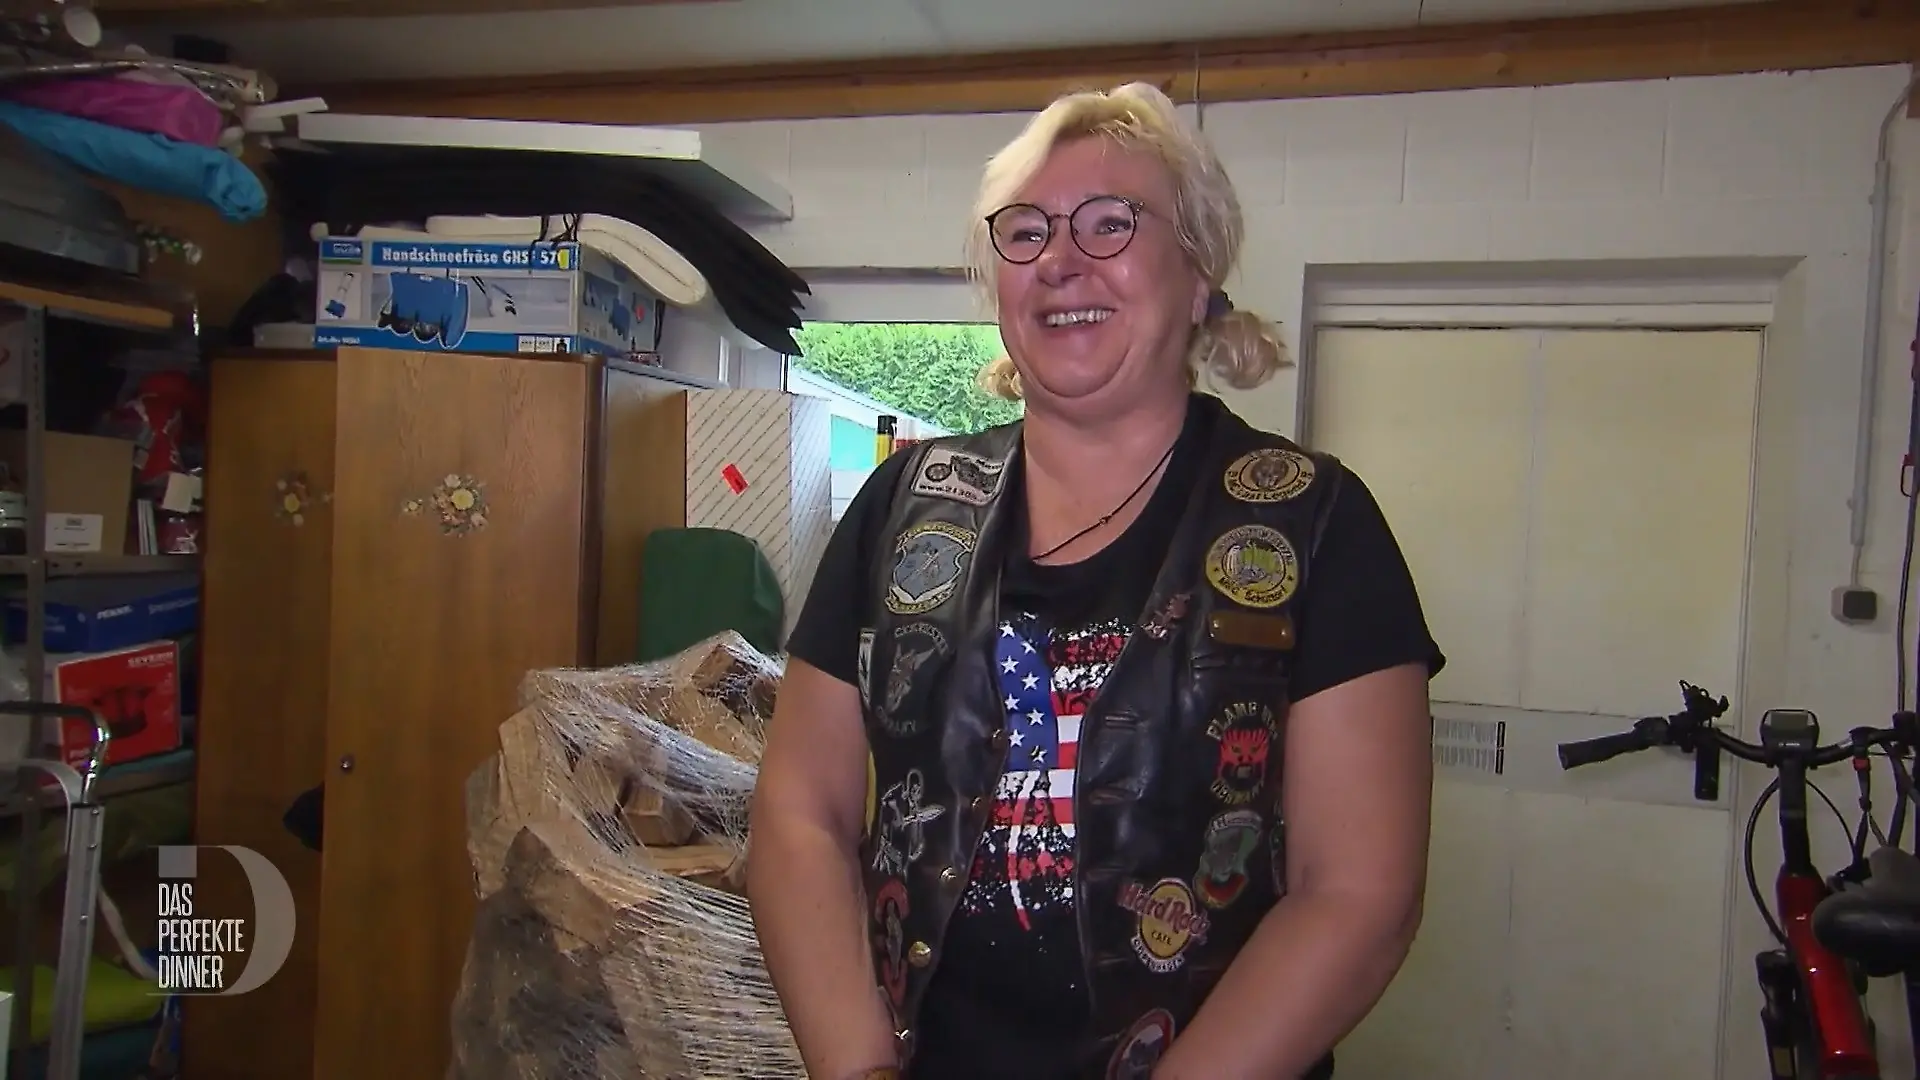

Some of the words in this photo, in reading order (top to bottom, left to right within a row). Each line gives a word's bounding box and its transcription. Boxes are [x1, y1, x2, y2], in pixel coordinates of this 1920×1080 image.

[382, 247, 499, 264] Handschneefräse
[1117, 883, 1175, 922] Hard
[1164, 898, 1210, 944] Rock
